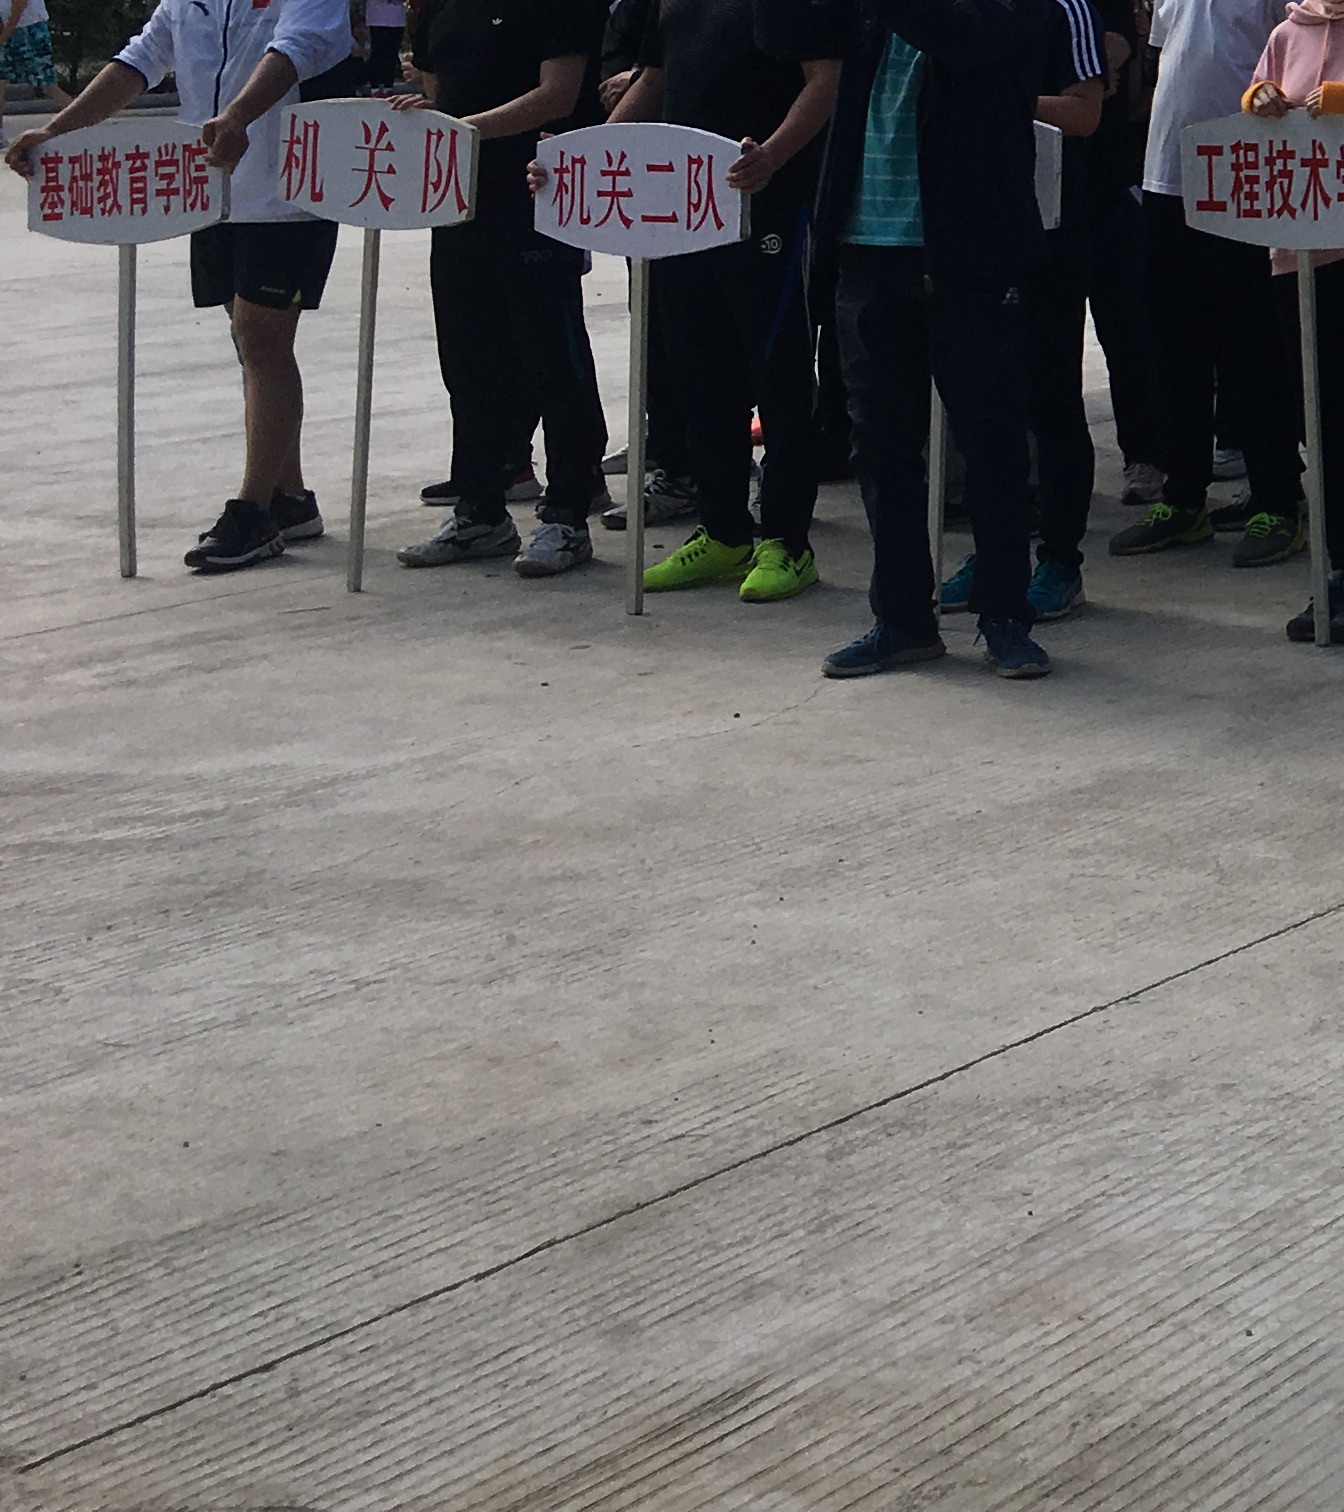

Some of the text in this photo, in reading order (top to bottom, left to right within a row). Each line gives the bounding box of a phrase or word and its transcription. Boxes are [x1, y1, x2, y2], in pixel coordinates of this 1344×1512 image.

[40, 140, 210, 222] 基础教育学院
[279, 112, 469, 215] 机关队
[552, 148, 726, 233] 机关二队
